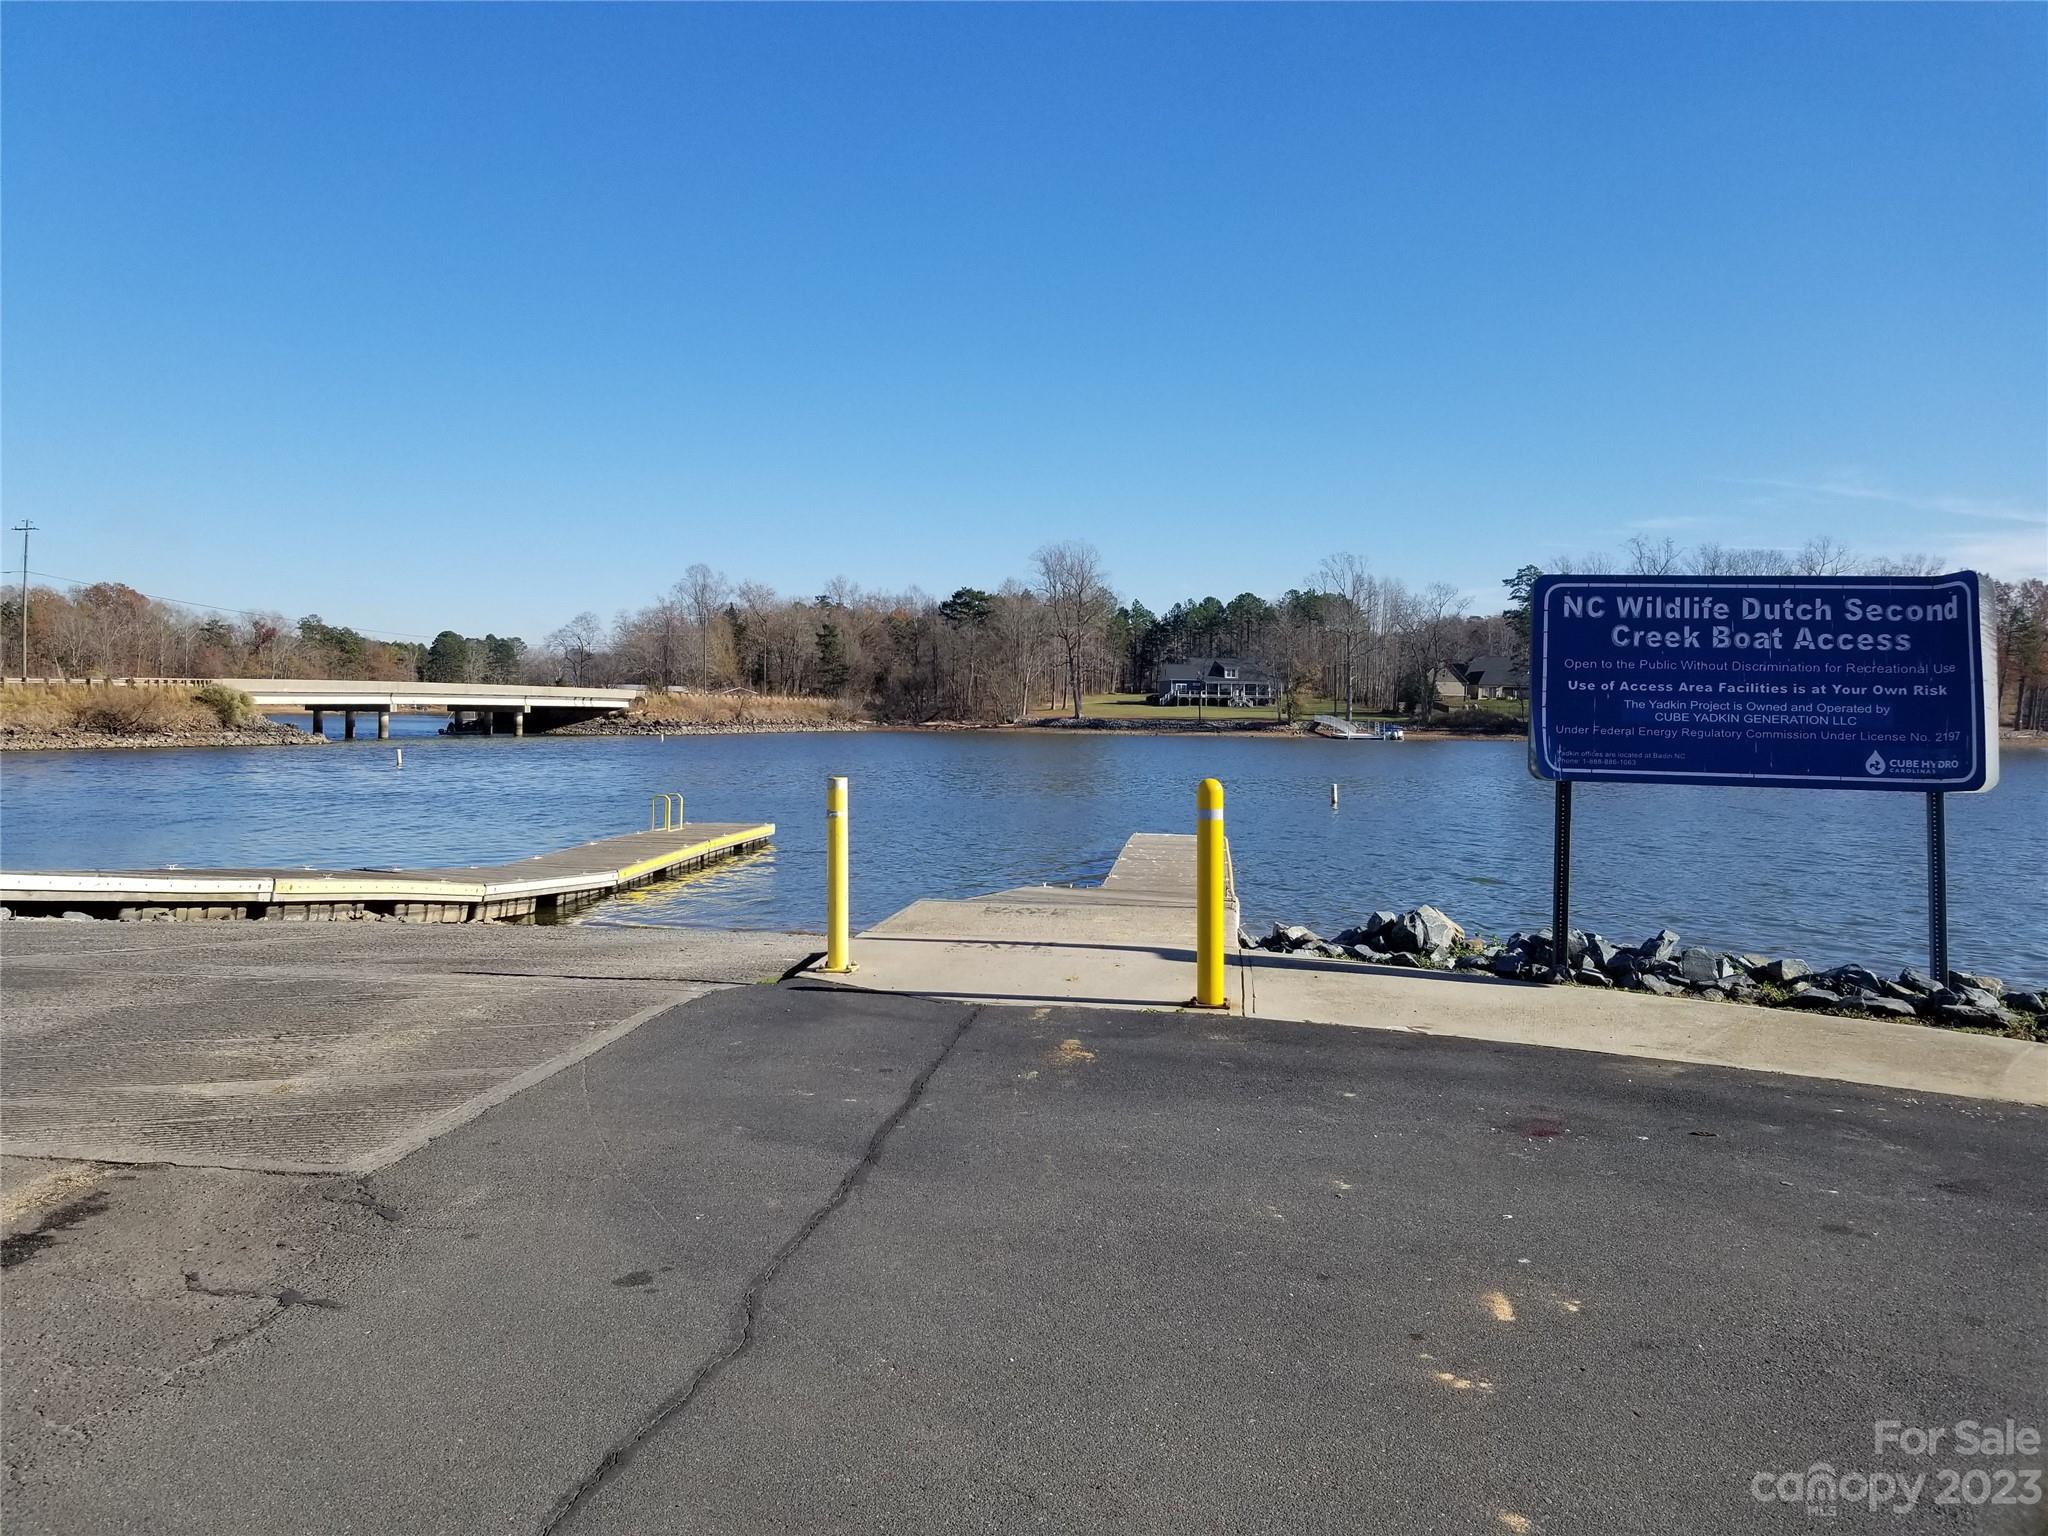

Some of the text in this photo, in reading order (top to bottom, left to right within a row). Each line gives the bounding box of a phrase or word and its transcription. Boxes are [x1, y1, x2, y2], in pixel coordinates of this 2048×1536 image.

[1563, 595, 1957, 621] NC Wildlife Dutch Second
[1611, 625, 1912, 650] Creek Boat Access
[1564, 659, 1955, 674] Open to the Public Without Discrimination for Recreational Use
[1568, 681, 1947, 695] Use of Access Area Facilities is at Your Own Risk
[1624, 700, 1890, 715] The Yadkin Project is Owned and Operated by
[1655, 713, 1857, 725] CUBE YADKIN GENERATION LLC
[1556, 725, 1960, 741] Under Federal Energy Regulatory Commission Under License No. 2197
[1889, 760, 1958, 768] CUBE HYDRO
